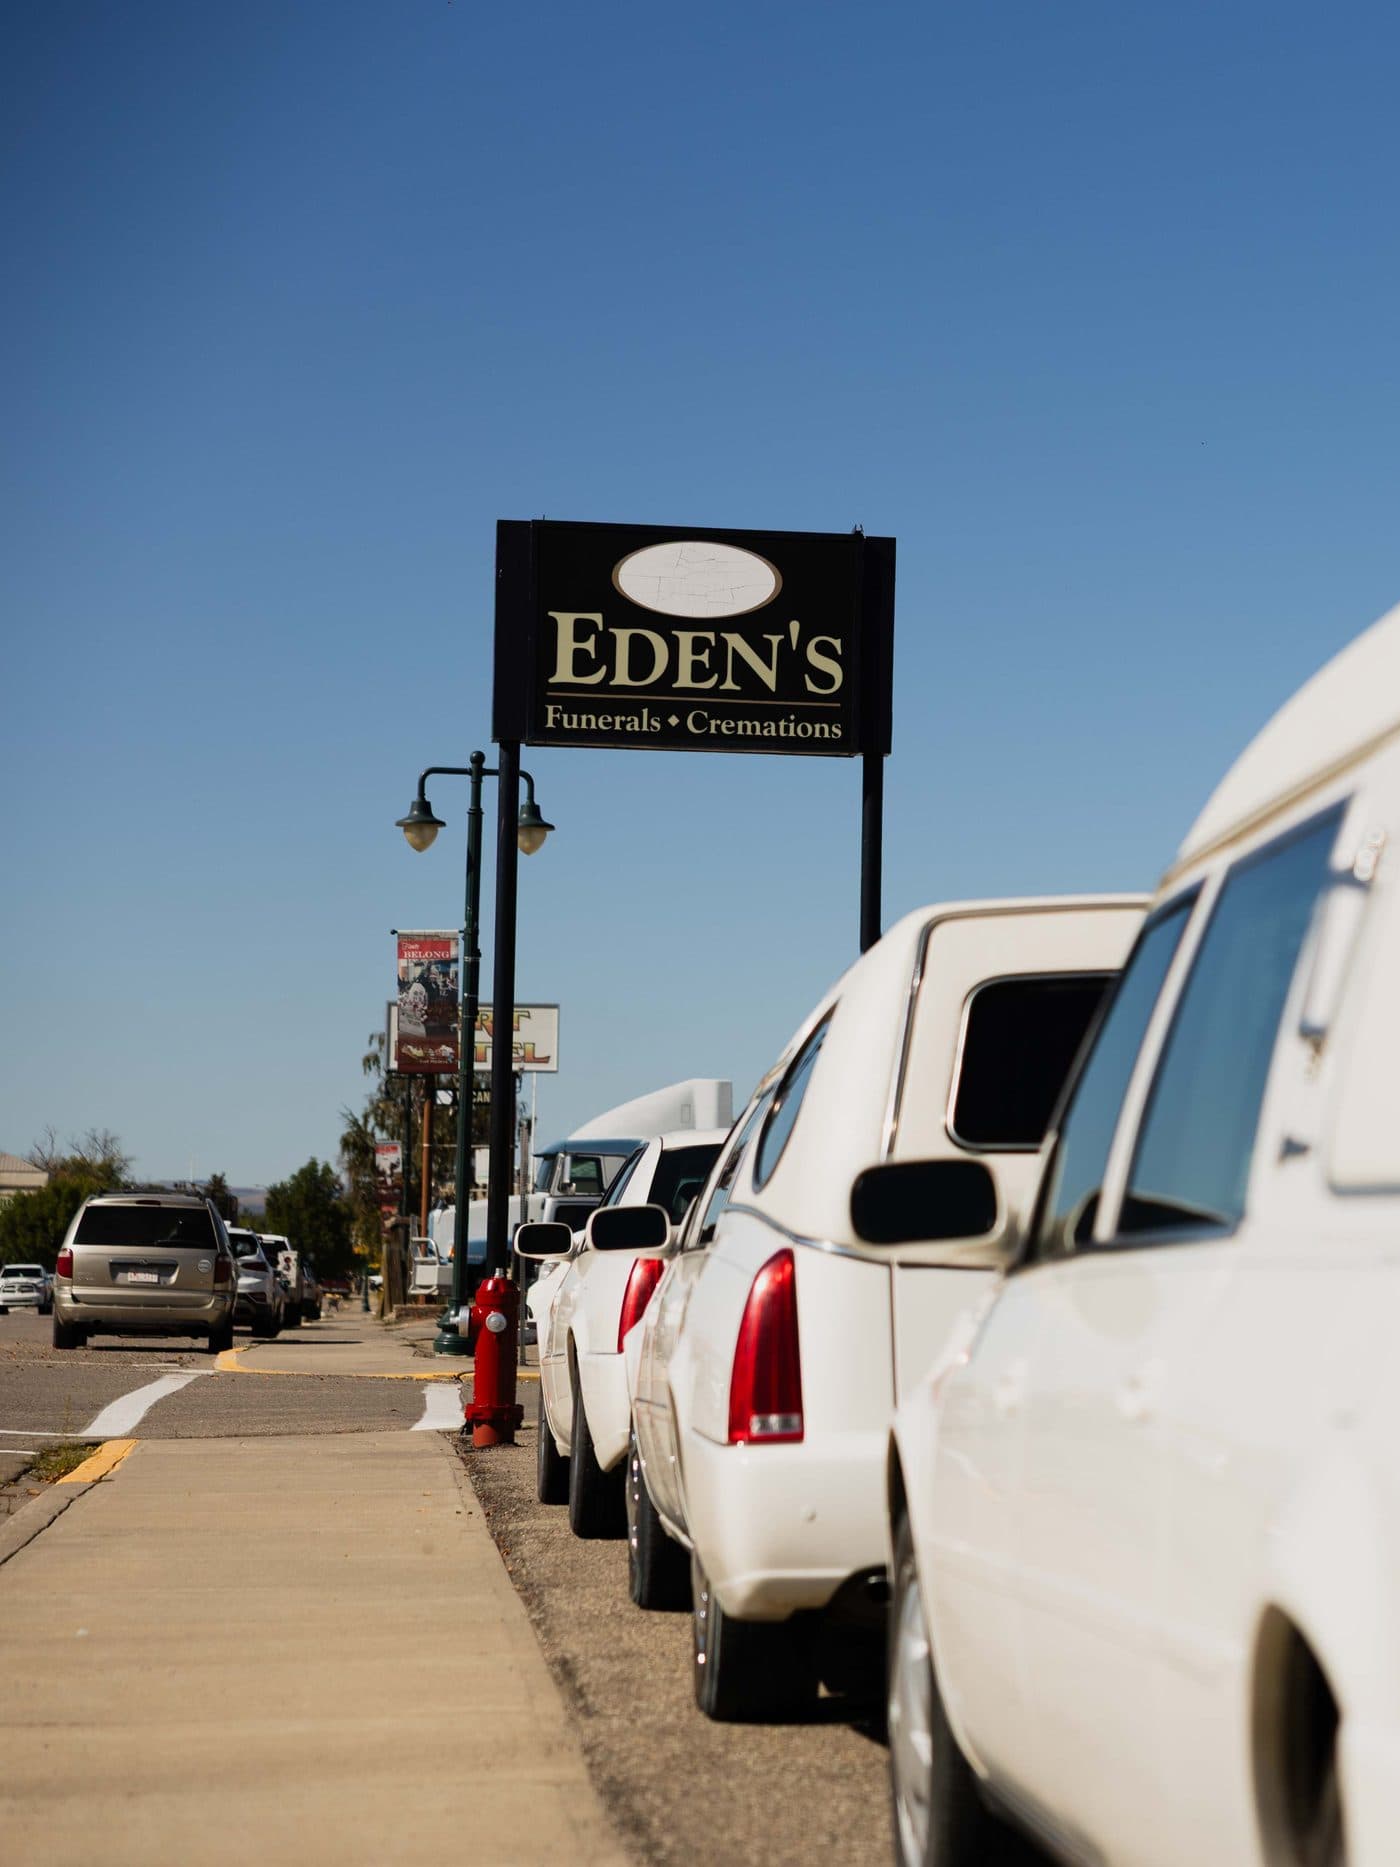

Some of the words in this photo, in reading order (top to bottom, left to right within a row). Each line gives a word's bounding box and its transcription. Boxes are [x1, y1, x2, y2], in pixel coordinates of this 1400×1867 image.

[547, 610, 844, 695] EDEN'S
[545, 704, 661, 733] Funerals
[686, 710, 843, 739] Cremations
[403, 950, 450, 959] BELONG
